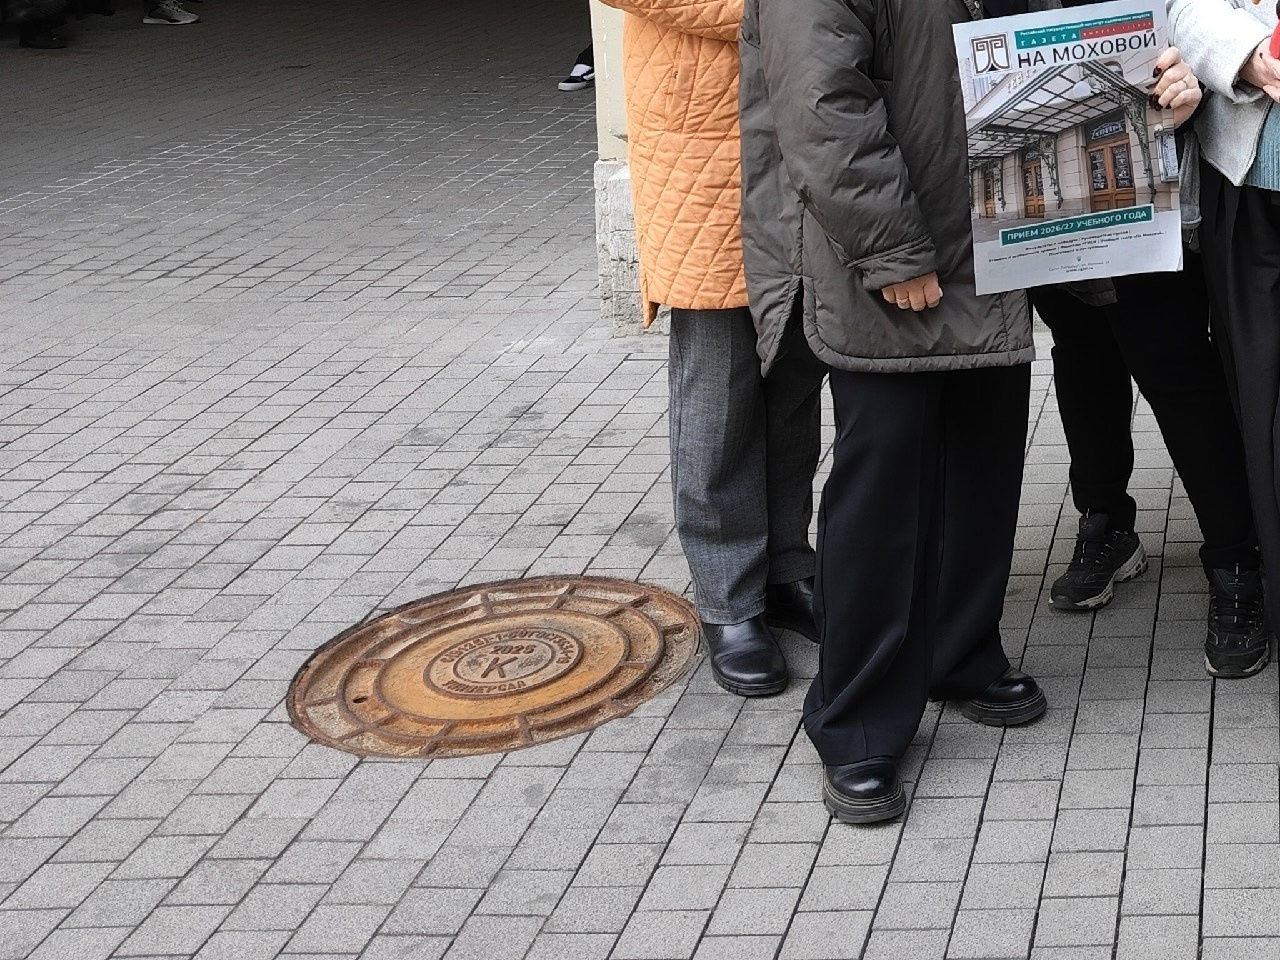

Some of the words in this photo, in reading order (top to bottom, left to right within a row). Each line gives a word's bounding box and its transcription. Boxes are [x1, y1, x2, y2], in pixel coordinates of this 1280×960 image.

[1017, 50, 1046, 69] НА
[1052, 29, 1157, 63] МОХОВОЙ
[1020, 33, 1077, 46] ГАЗЕТА
[1007, 229, 1039, 241] ПРИЕМ
[1040, 222, 1074, 235] 2026/27
[1076, 215, 1122, 228] УЧЕБНОГО
[1123, 210, 1147, 220] ГОДА
[489, 644, 537, 655] 2025
